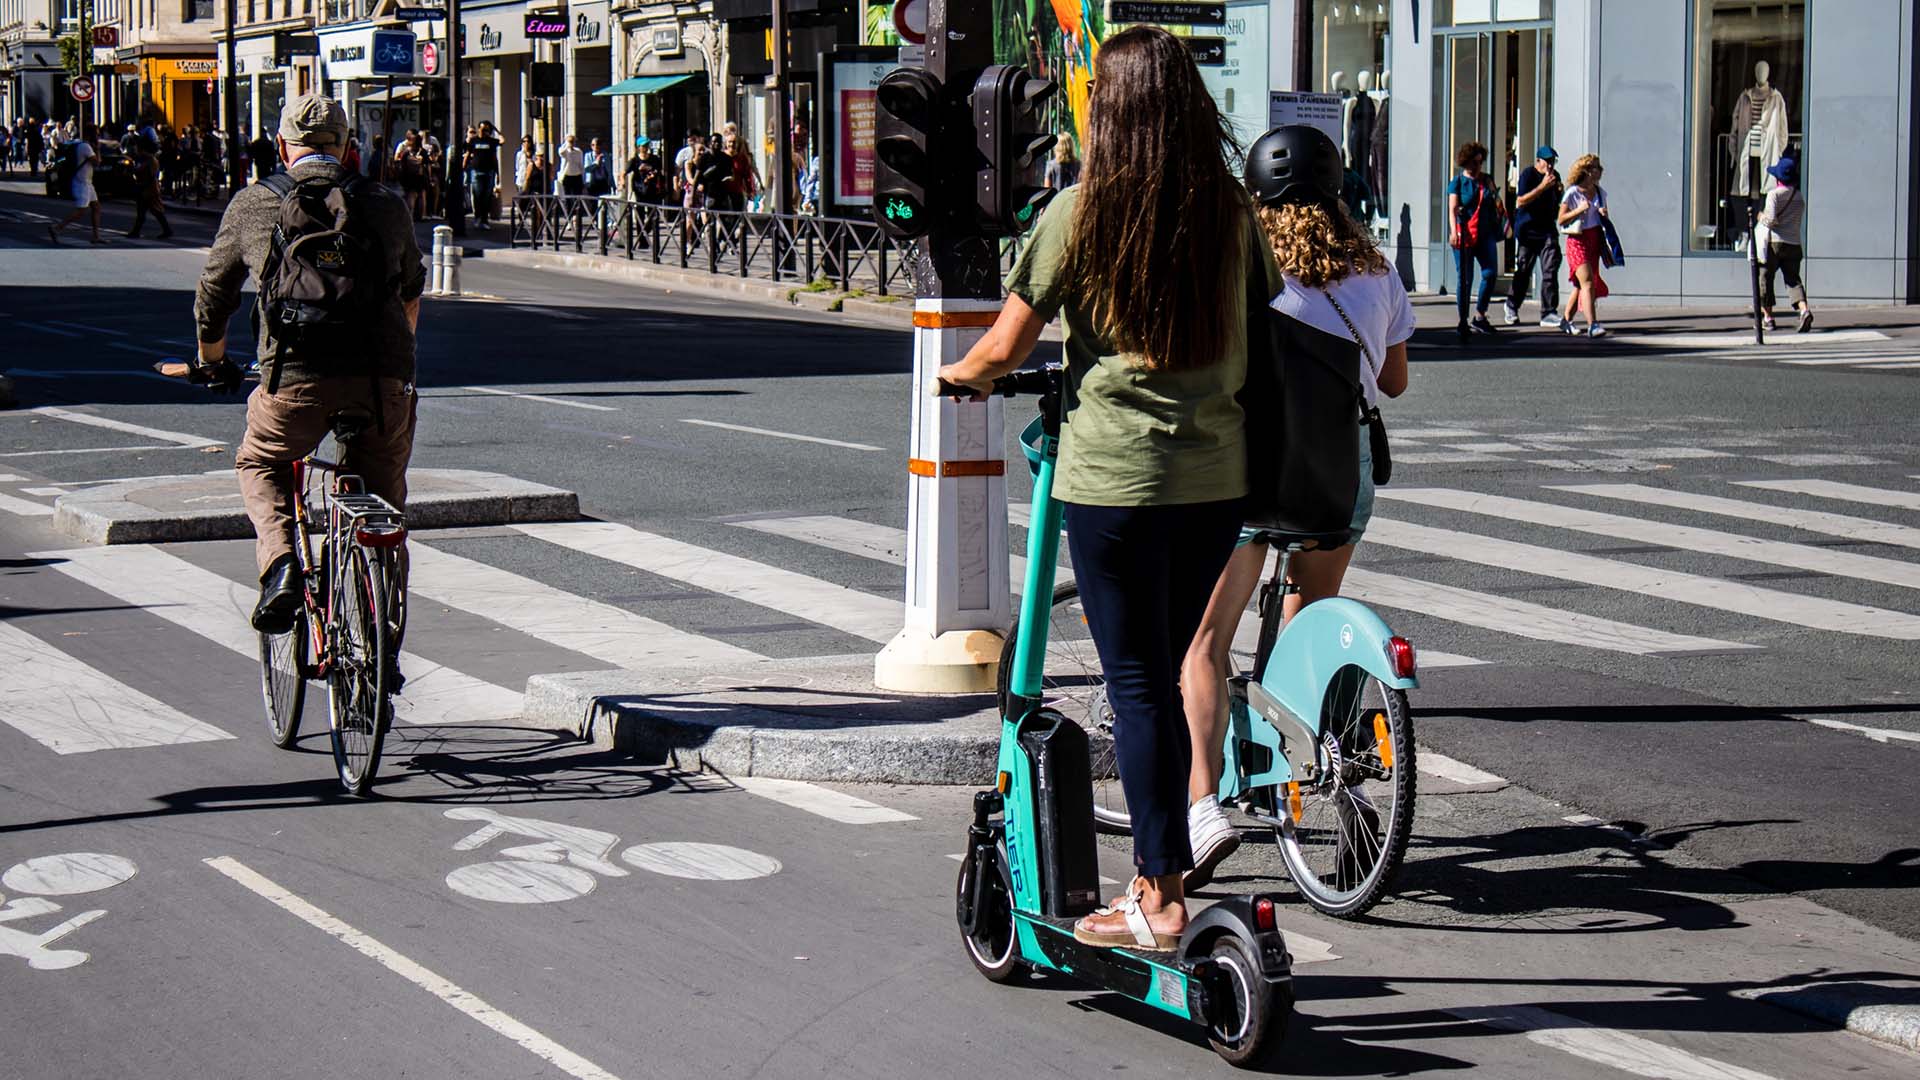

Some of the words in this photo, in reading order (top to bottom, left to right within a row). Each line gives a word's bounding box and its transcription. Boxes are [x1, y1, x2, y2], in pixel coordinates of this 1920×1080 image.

[1174, 5, 1201, 14] Renard
[527, 19, 566, 33] Etam
[1006, 808, 1023, 894] TIER
